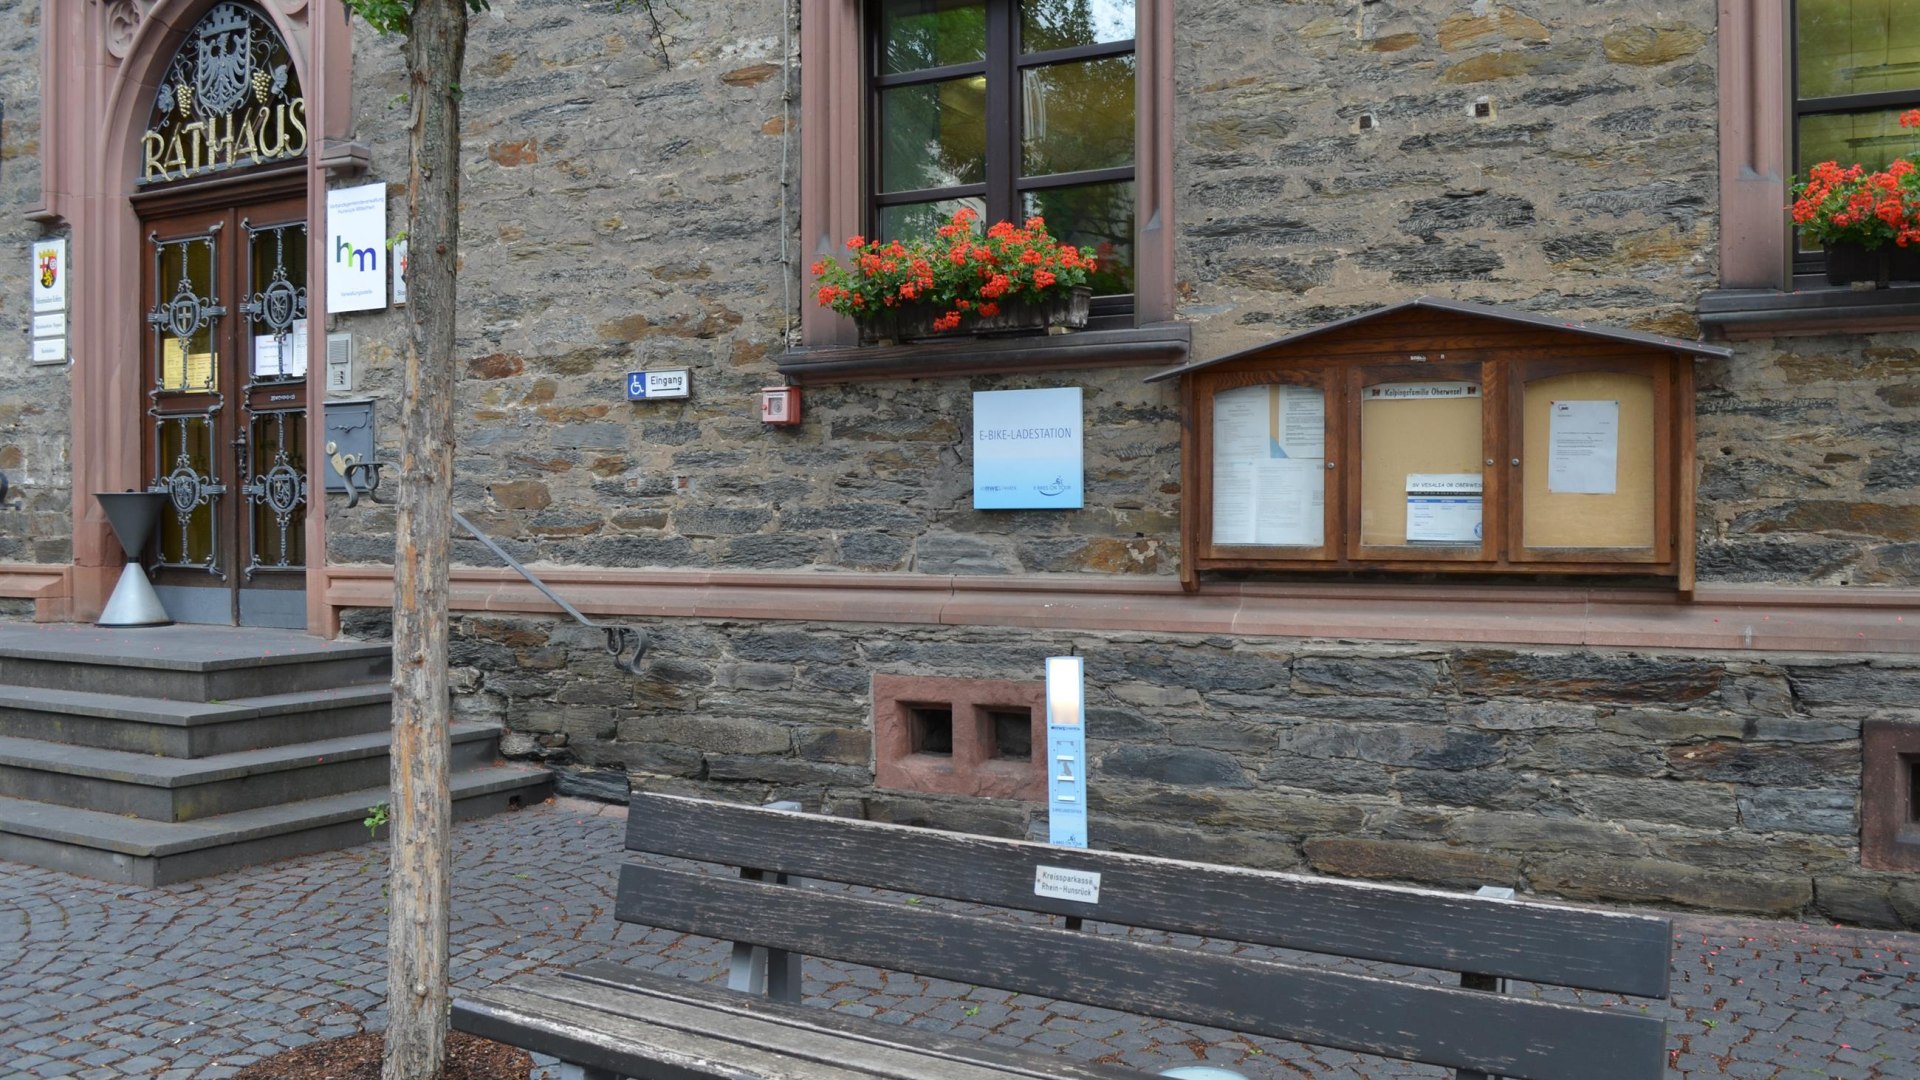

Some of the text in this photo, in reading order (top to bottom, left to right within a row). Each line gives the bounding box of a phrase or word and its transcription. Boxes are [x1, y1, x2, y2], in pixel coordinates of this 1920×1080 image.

[141, 98, 307, 183] RATHAUS
[651, 375, 682, 387] Eingang
[1384, 386, 1463, 399] Kolpingsfamilie Oberwesel
[979, 427, 1071, 440] E-BIKE-LADESTATION
[1042, 871, 1093, 885] Kreissparkasse
